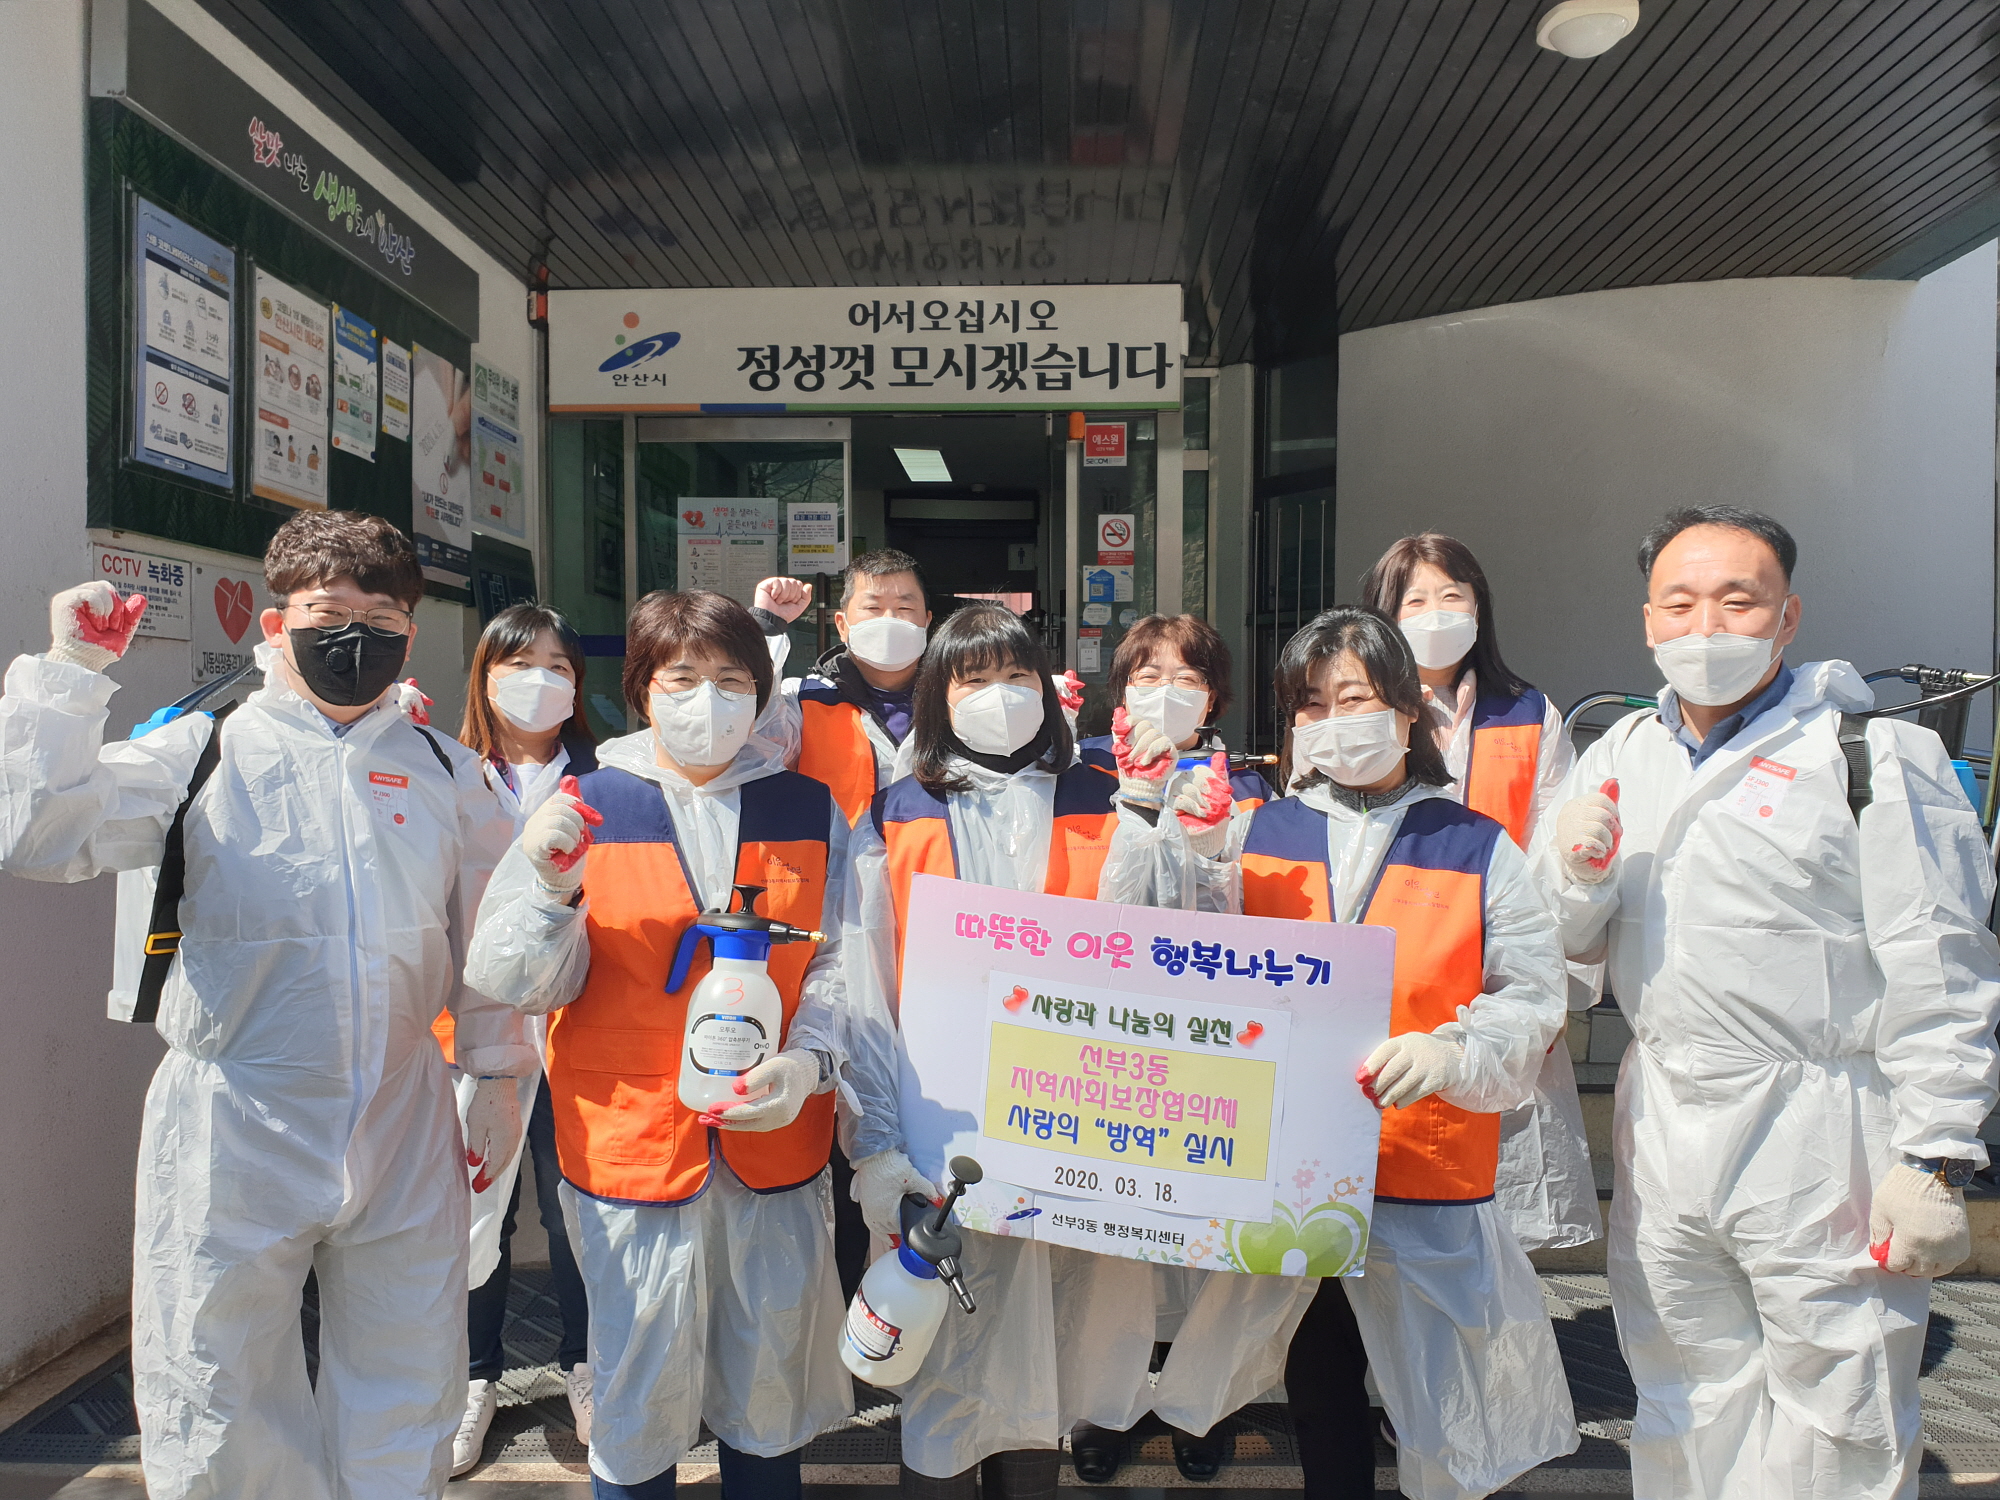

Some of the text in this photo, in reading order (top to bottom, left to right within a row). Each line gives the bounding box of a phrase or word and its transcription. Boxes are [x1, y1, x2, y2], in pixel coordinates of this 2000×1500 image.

[249, 116, 283, 168] 살맛
[284, 152, 309, 192] 나는
[848, 300, 1059, 334] 어서오십시오
[612, 373, 667, 387] 안산시
[737, 342, 1174, 393] 정성껏 모시겠습니다
[1092, 434, 1120, 446] 에스원
[1086, 457, 1109, 465] SECOM
[726, 519, 776, 531] 골든타임 4분
[102, 553, 184, 587] CCTV 녹화중
[373, 774, 403, 785] ANYSAFE
[1757, 761, 1791, 776] ANYSAFE
[955, 912, 1332, 988] 따뜻한 이웃 행복나누기
[723, 977, 745, 1006] 3
[719, 1026, 737, 1034] 오투오
[1031, 994, 1234, 1047] 사랑과 나눔의 실천
[1079, 1045, 1170, 1086] 선부3동
[1011, 1066, 1238, 1129] 지역사회보장협의체
[1008, 1105, 1235, 1167] 사랑의 “방역” 실시
[1054, 1166, 1178, 1204] 2020. 03. 18.
[1051, 1212, 1185, 1247] 선부3동 행정복지센터
